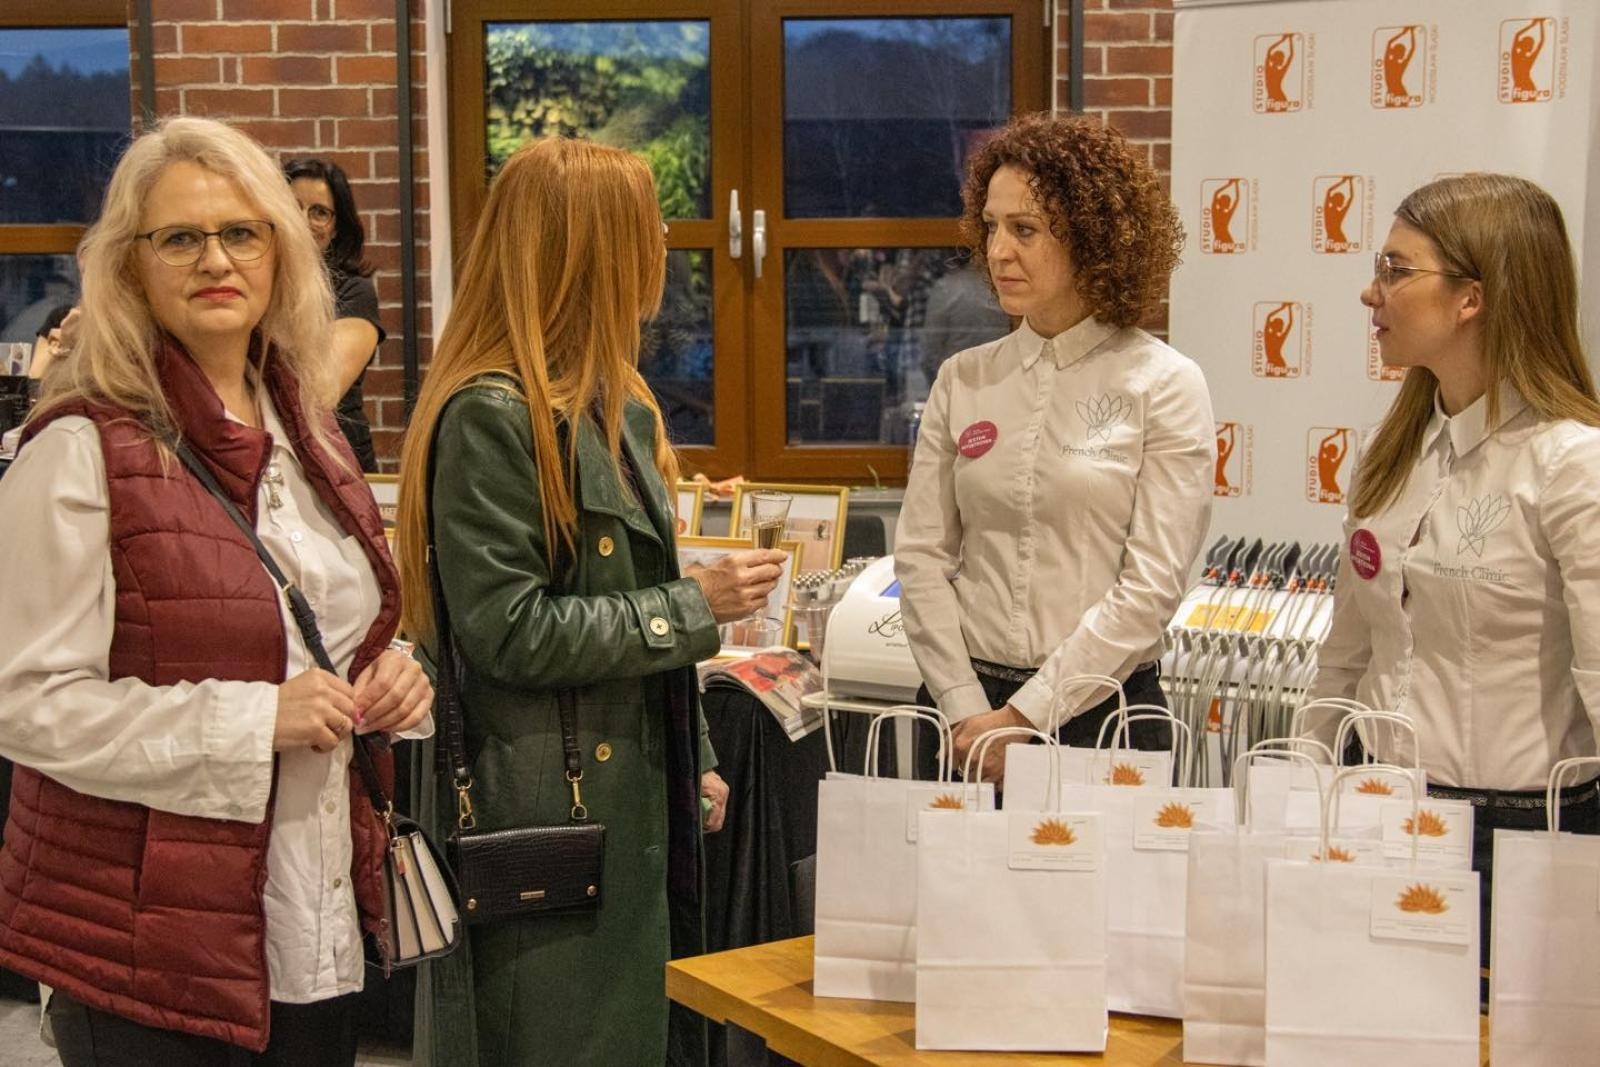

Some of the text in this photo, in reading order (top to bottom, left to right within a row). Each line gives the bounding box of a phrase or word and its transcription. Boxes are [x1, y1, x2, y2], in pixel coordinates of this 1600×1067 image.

[1374, 59, 1382, 104] STUDIO
[1501, 53, 1510, 98] STUDIO
[1256, 65, 1264, 109] STUDIO
[1386, 94, 1421, 107] figura
[1513, 88, 1550, 102] figura
[1267, 98, 1300, 111] figura
[1203, 208, 1211, 249] STUDIO
[1315, 207, 1323, 248] STUDIO
[1213, 240, 1245, 252] figura
[1327, 239, 1359, 252] figura
[1255, 330, 1263, 372] STUDIO
[1370, 333, 1378, 376] STUDIO
[1266, 363, 1298, 376] figura
[1382, 366, 1405, 380] figu
[1063, 445, 1097, 457] French
[1309, 456, 1317, 497] STUDIO
[1216, 485, 1239, 497] gura
[1320, 489, 1345, 502] figur
[1433, 562, 1469, 577] French
